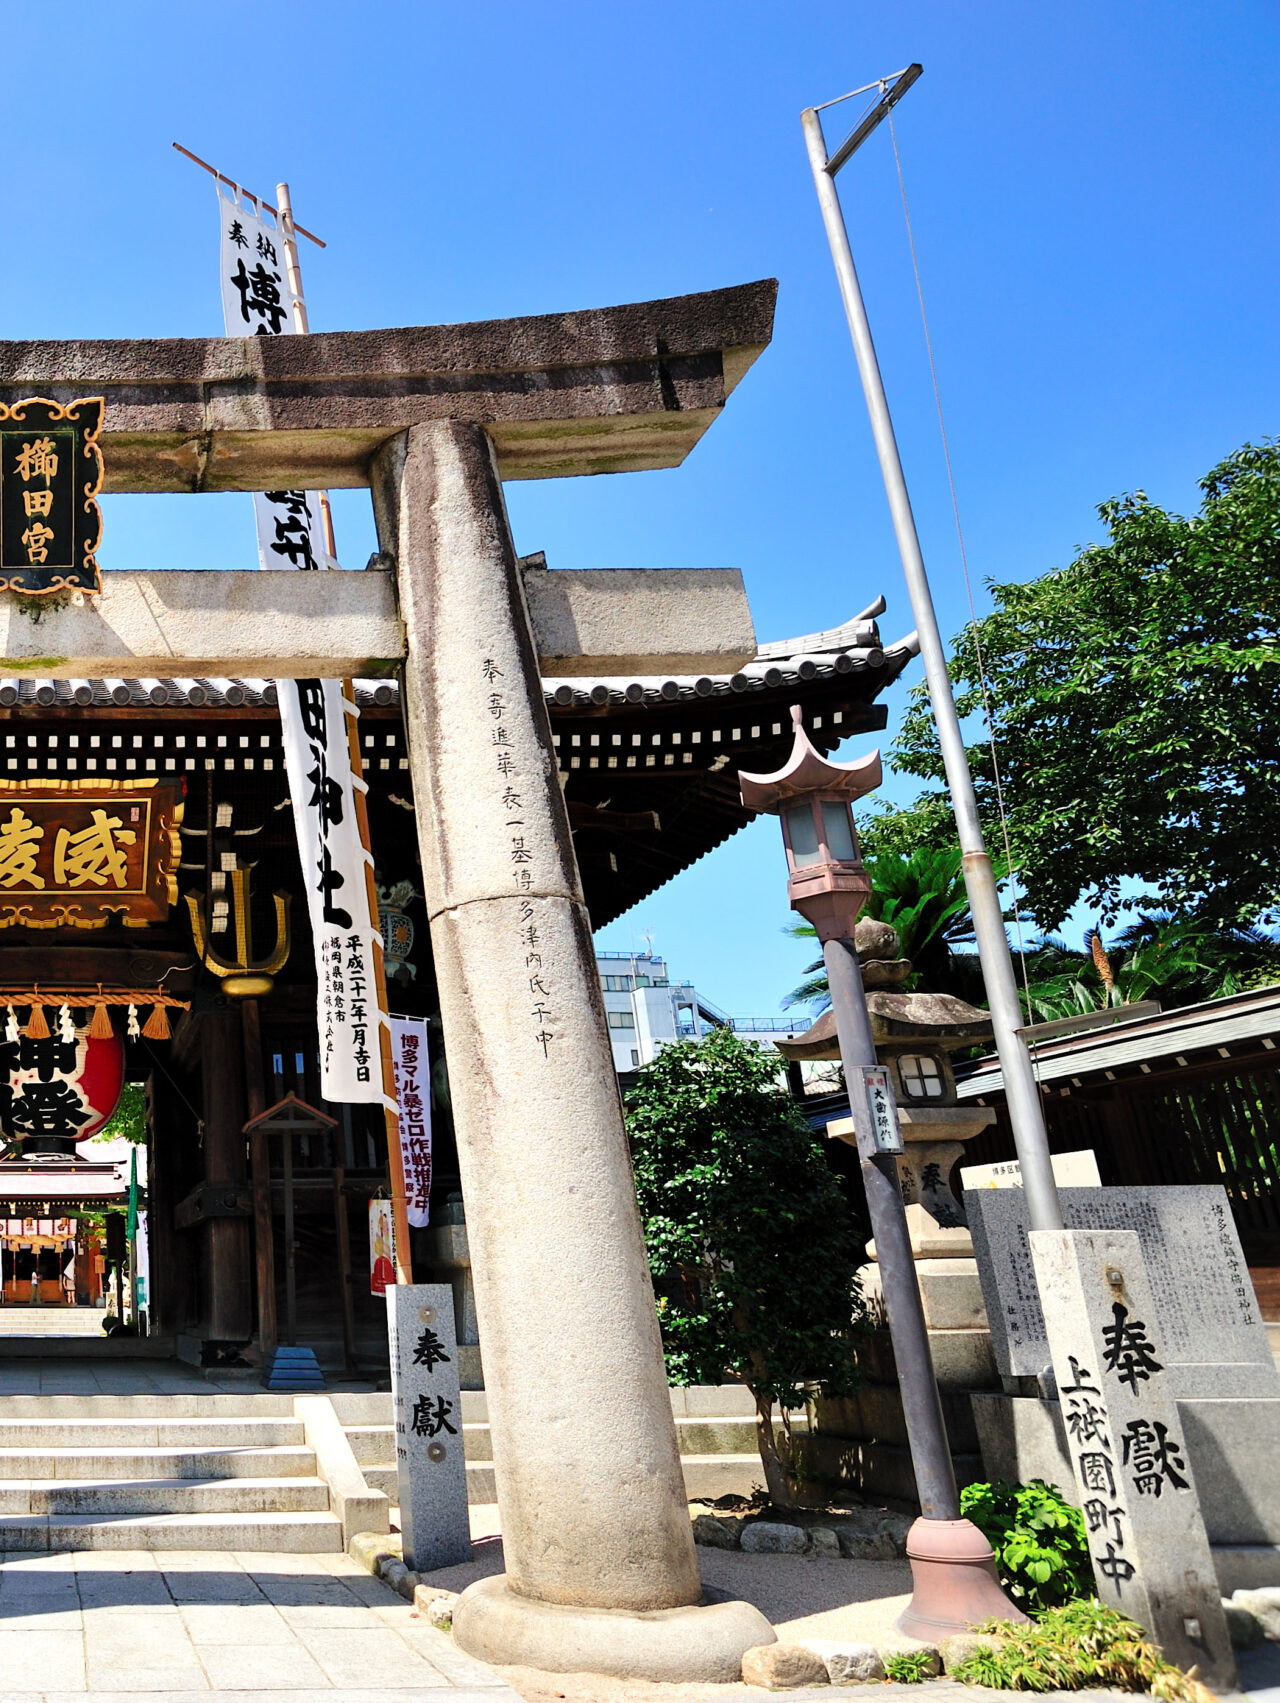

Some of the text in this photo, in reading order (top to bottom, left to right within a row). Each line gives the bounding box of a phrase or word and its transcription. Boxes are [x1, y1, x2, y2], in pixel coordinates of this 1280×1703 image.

[12, 436, 59, 563] 櫛田宮
[345, 934, 371, 1082] 平成二十一年一月吉日
